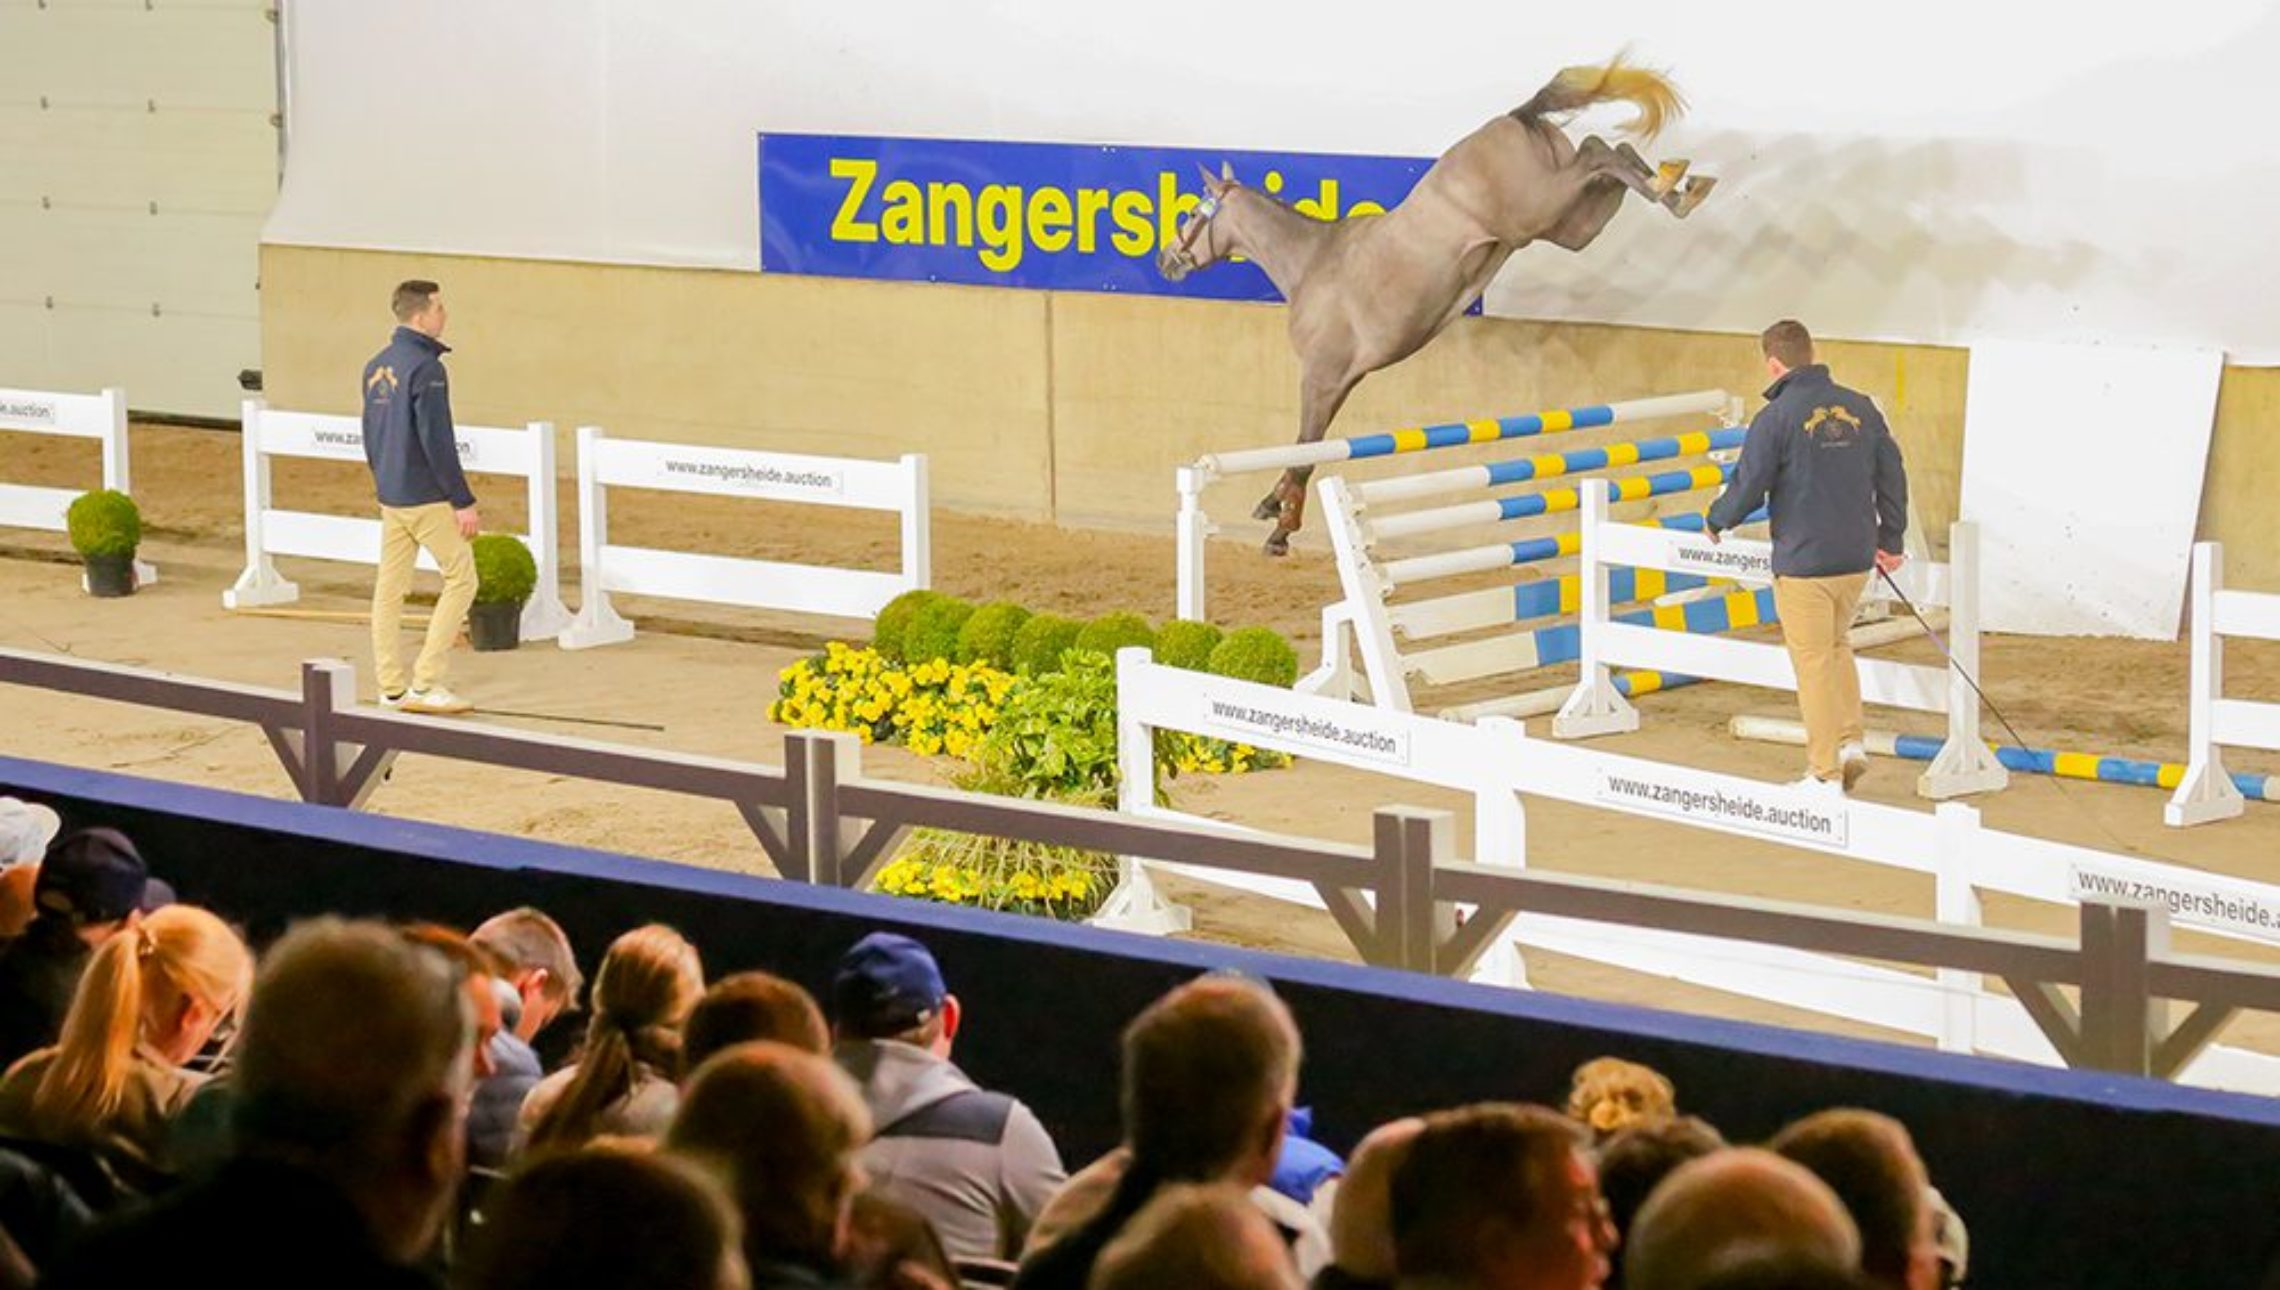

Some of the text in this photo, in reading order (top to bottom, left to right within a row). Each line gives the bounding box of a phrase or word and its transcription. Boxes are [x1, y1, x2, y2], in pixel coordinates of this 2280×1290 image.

[830, 158, 1387, 272] Zangersh
[666, 459, 833, 487] www.zangersheide.auction
[1678, 547, 1770, 572] www.zangers
[1212, 700, 1397, 753] www.zangersheide.auction
[1608, 775, 1832, 834] www.zangersheide.auction
